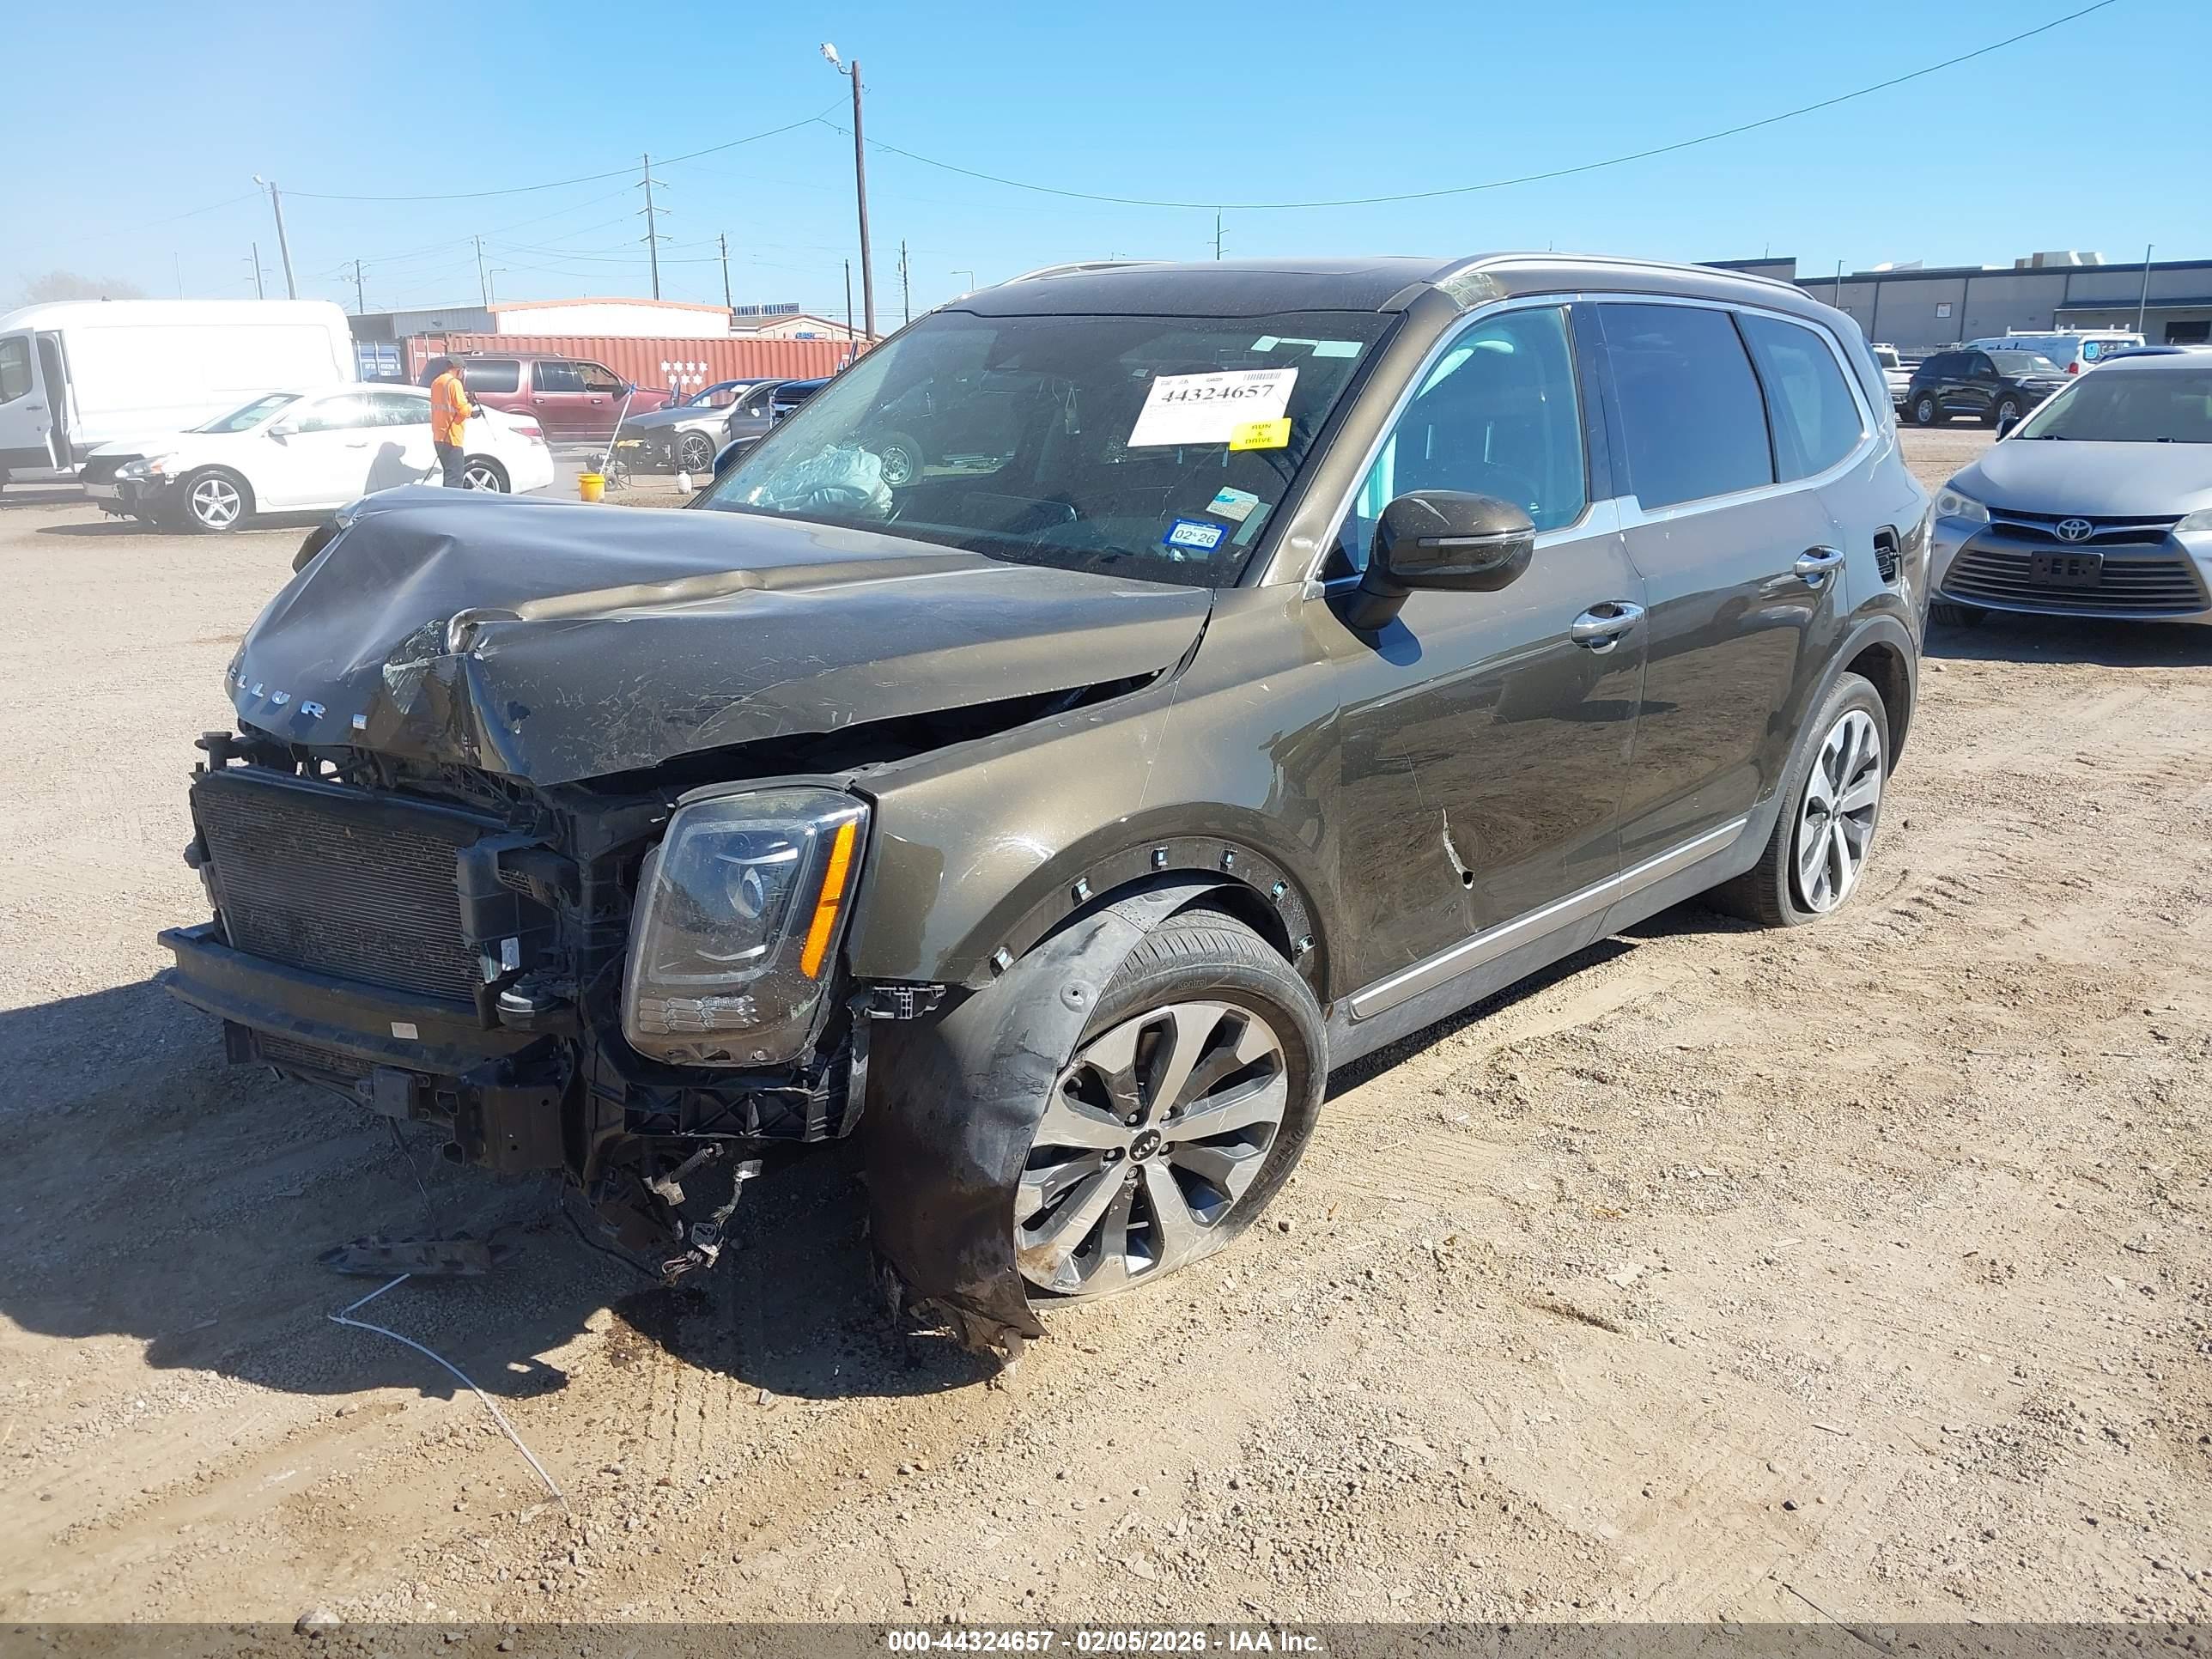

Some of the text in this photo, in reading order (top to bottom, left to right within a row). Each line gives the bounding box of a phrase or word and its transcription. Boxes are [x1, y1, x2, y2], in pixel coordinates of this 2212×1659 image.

[1161, 384, 1275, 403] 44324657
[1175, 529, 1193, 540] 02
[1198, 533, 1216, 544] 26
[1133, 1135, 1159, 1158] KIA
